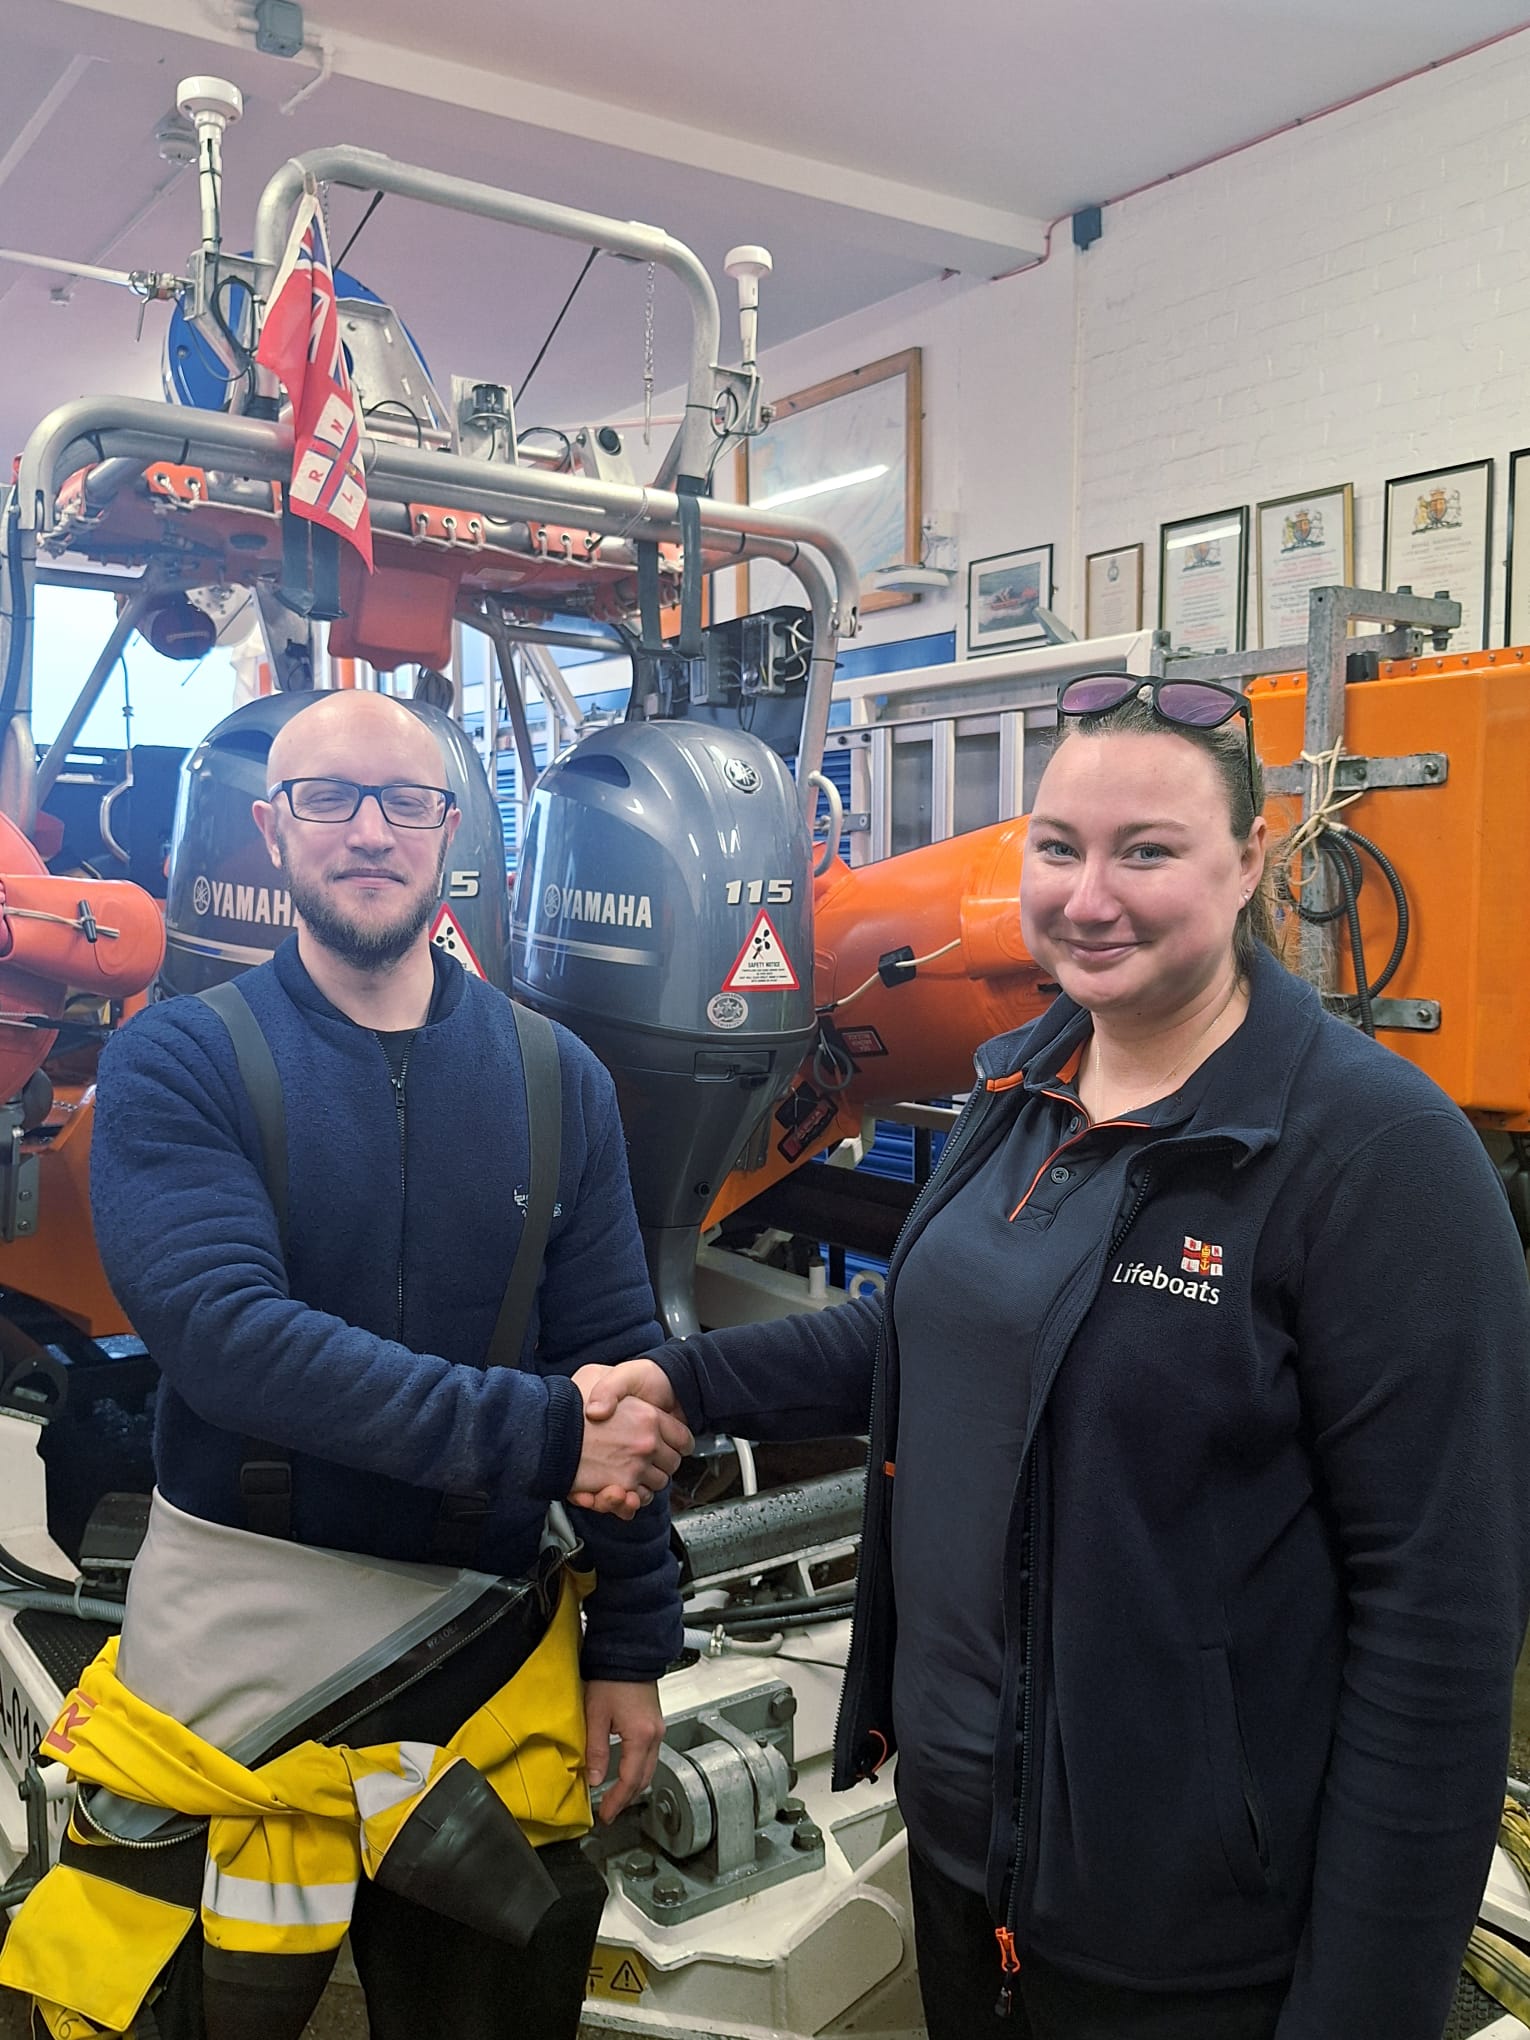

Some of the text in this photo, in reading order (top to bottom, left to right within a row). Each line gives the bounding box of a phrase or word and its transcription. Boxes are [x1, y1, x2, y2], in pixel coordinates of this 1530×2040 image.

[562, 887, 652, 929] YAMAHA
[725, 880, 794, 904] 115
[1111, 1262, 1220, 1305] Lifeboats
